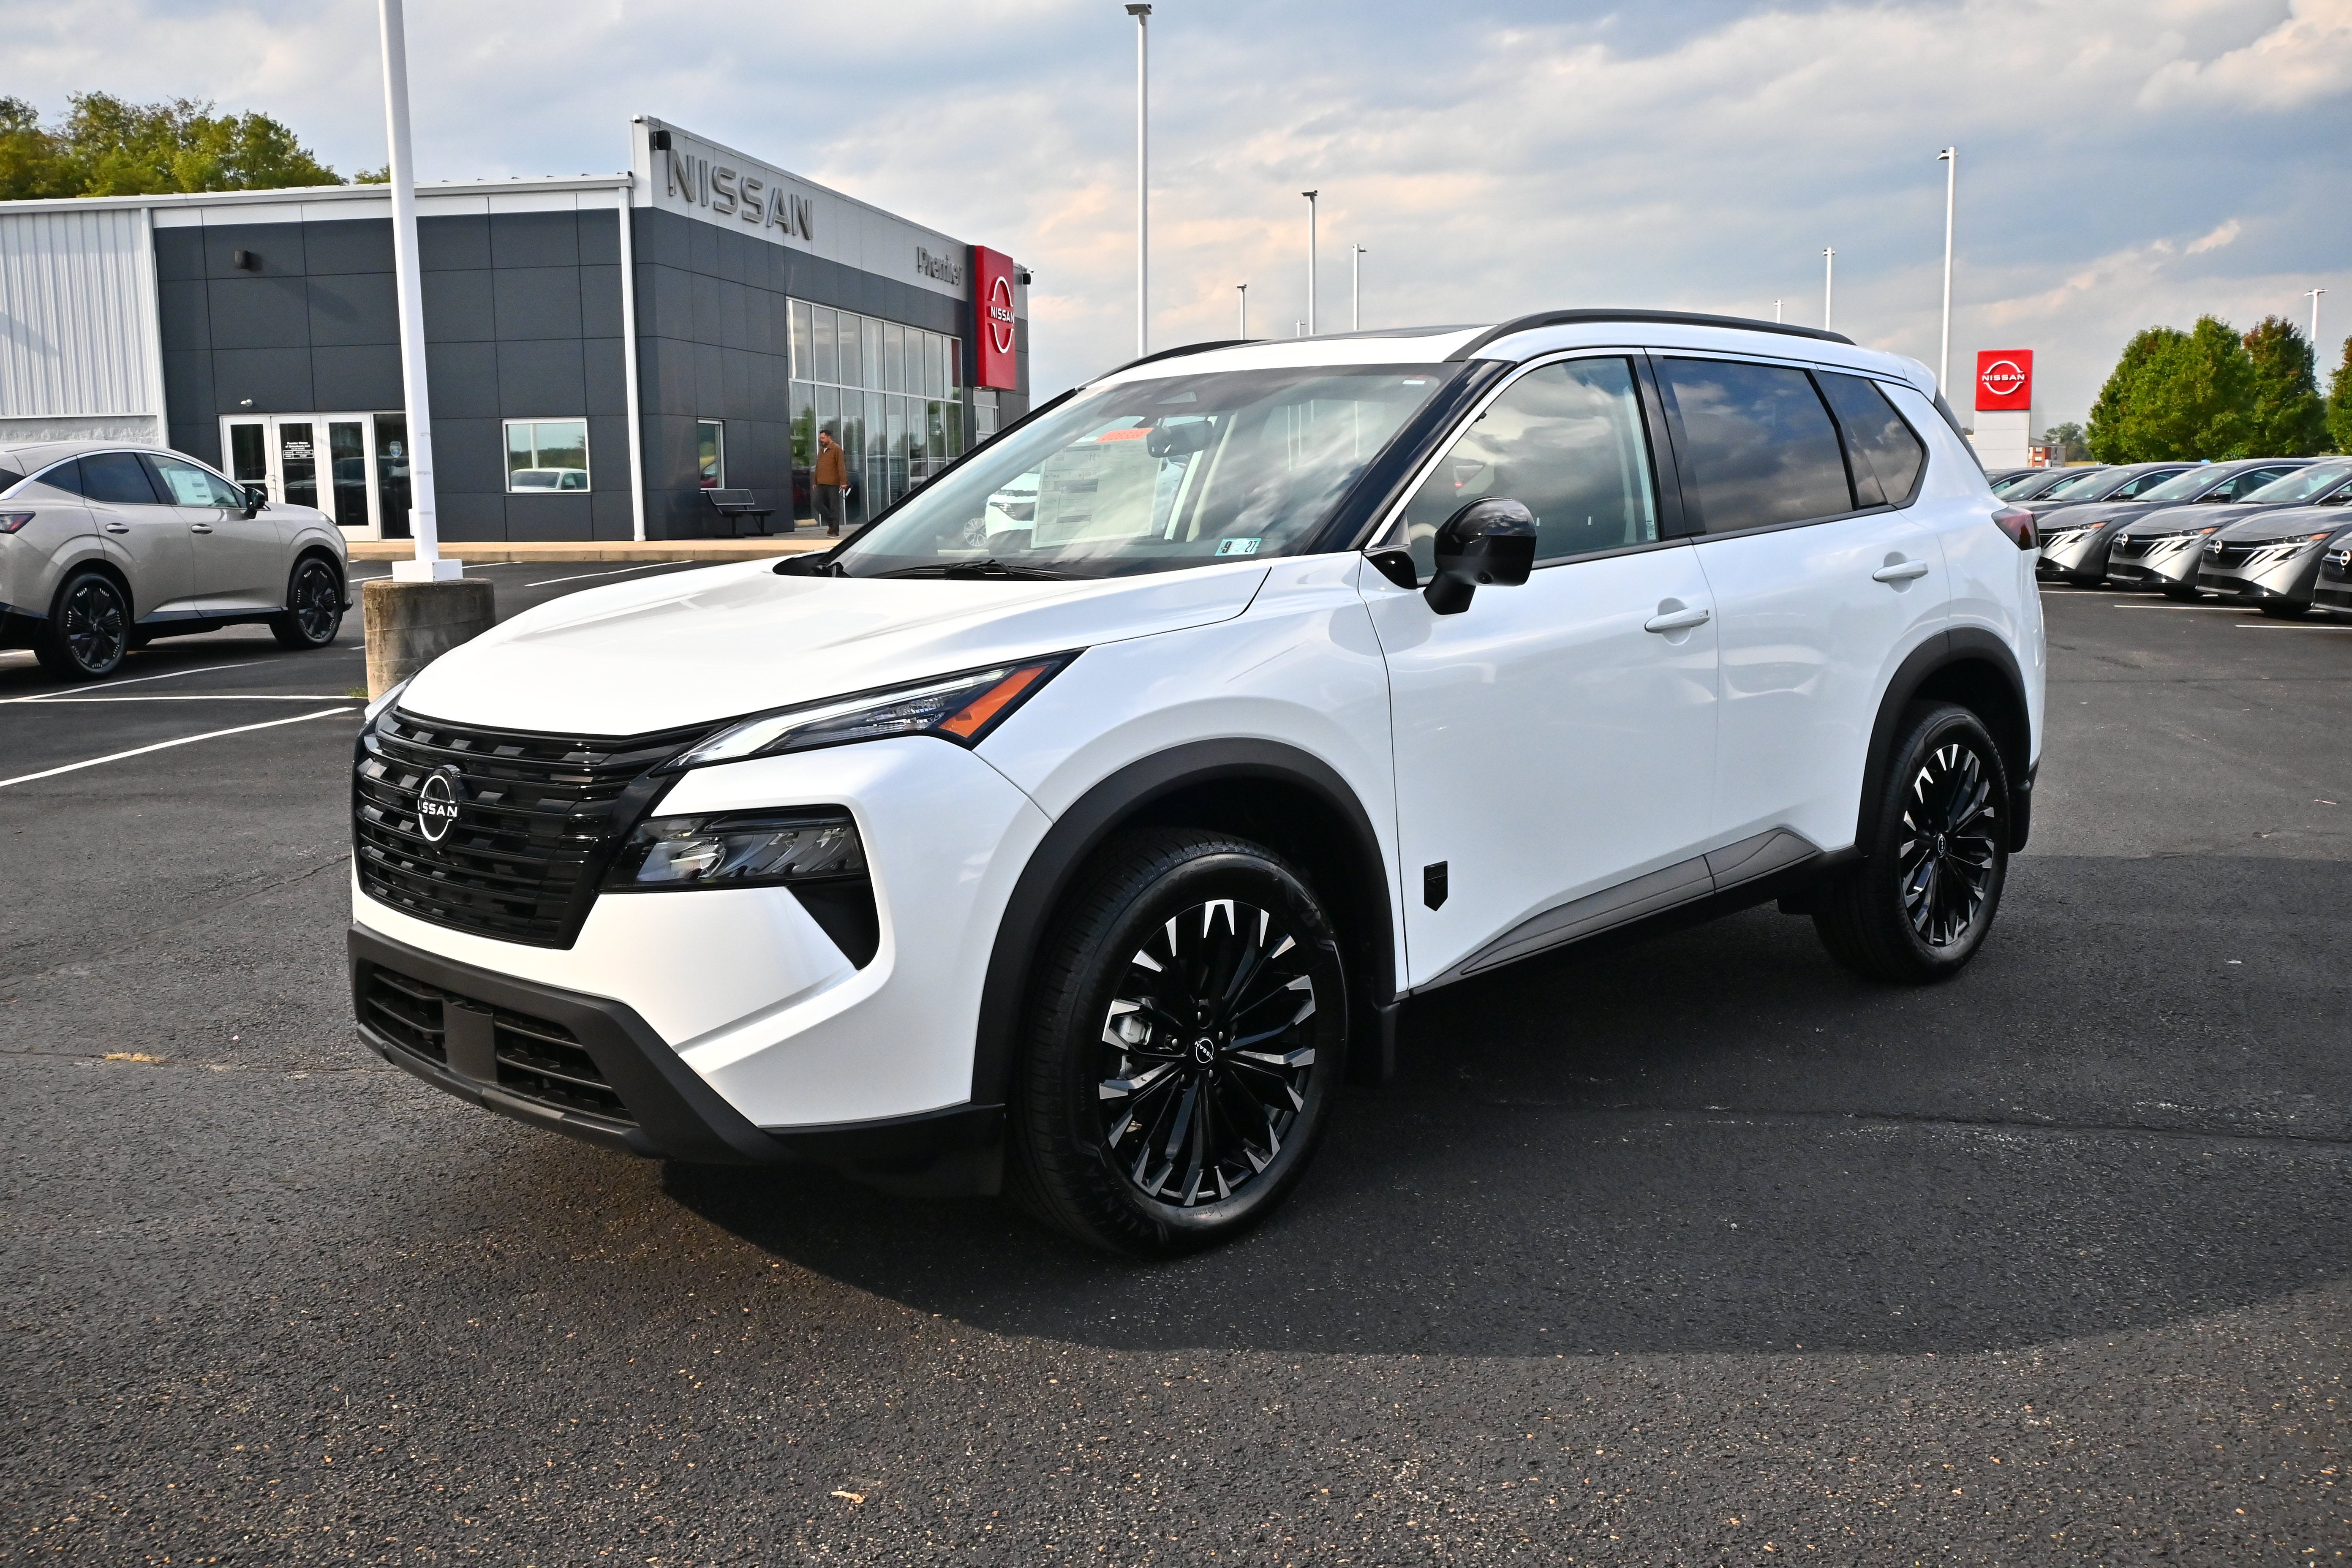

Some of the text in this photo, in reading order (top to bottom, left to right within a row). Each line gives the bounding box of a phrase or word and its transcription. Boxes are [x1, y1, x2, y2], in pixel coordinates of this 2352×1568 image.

[667, 148, 813, 240] NISSAN
[991, 305, 1015, 324] NISSAN
[1222, 541, 1258, 553] 9 27
[1195, 1041, 1214, 1061] NISSAN
